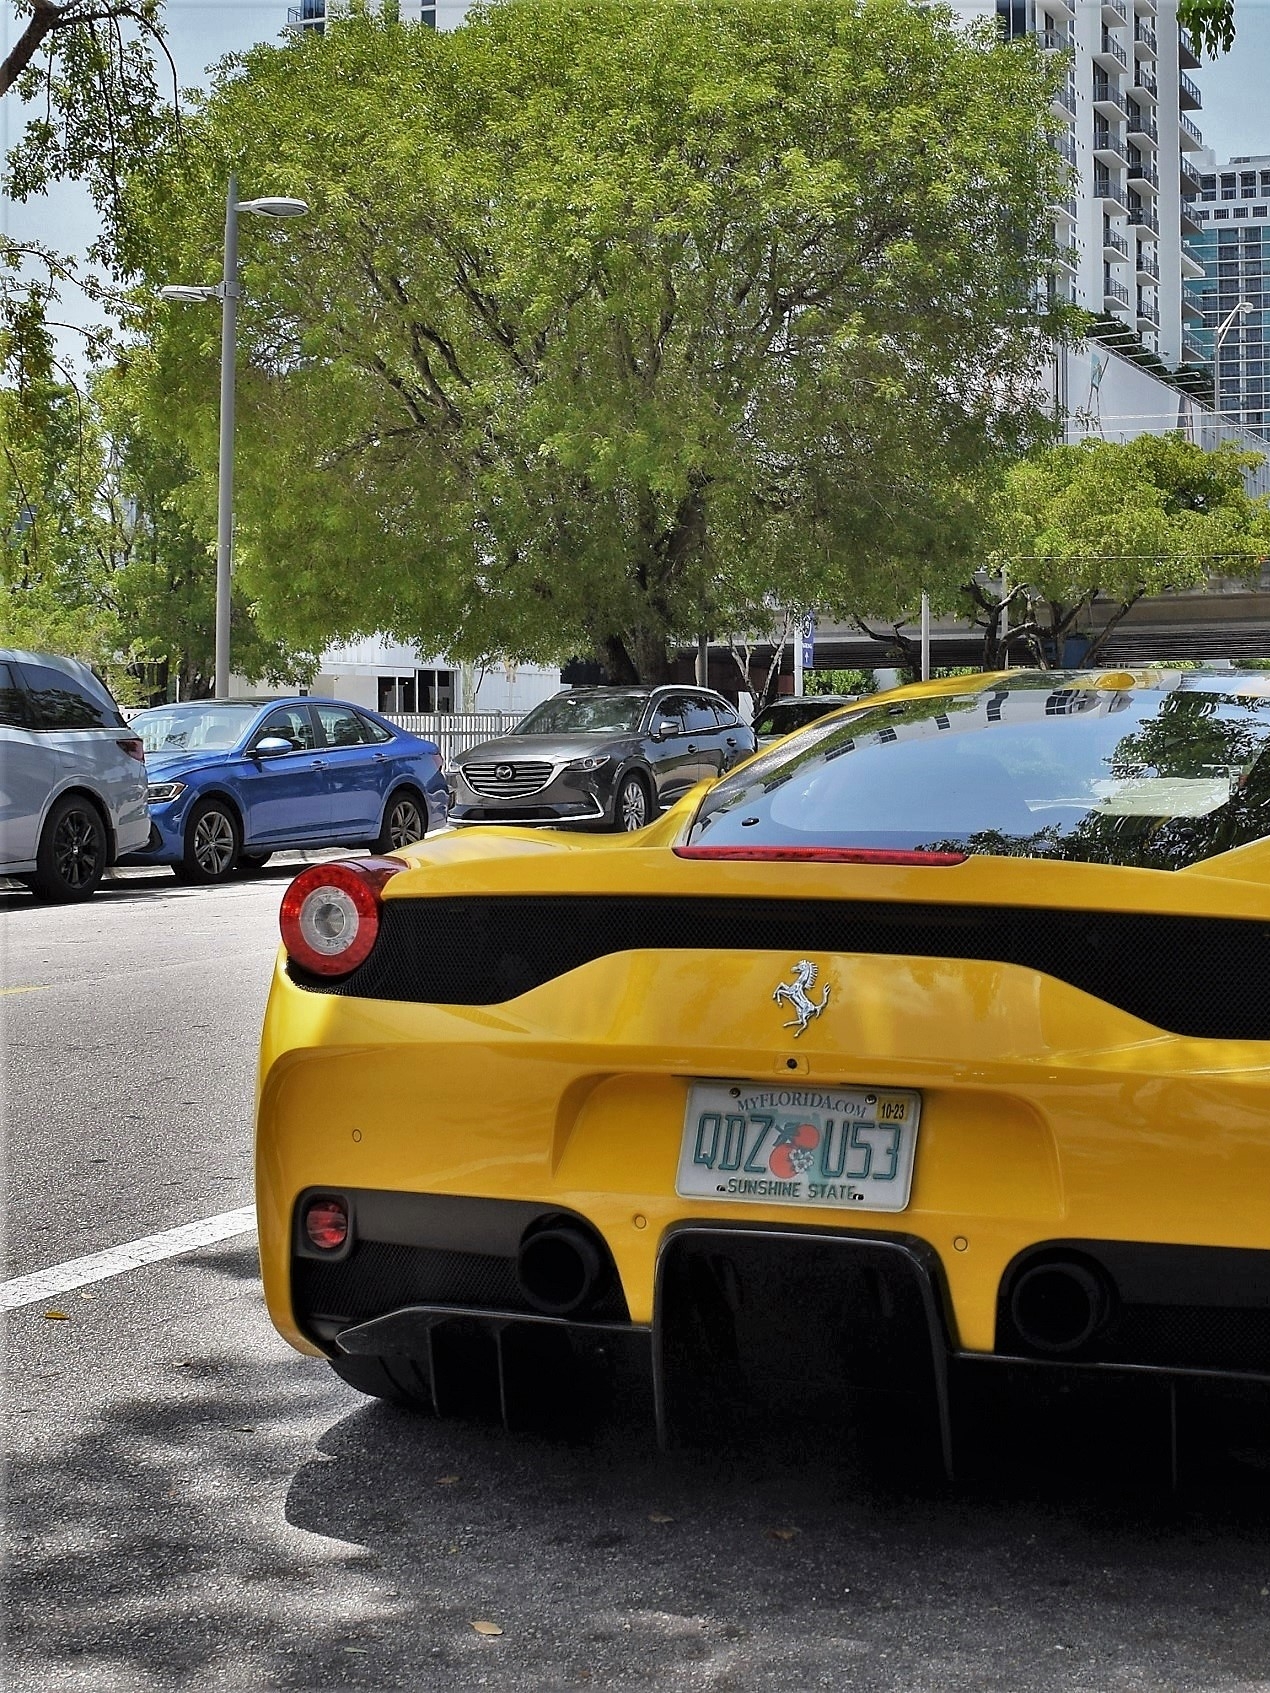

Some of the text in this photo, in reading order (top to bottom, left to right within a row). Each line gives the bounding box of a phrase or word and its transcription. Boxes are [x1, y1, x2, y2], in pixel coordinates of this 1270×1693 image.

[737, 1092, 867, 1118] MYFLORIDA.COM
[881, 1103, 905, 1120] 10-23
[694, 1113, 902, 1180] QDZ U53
[728, 1177, 856, 1200] SUNSHINE STATE
